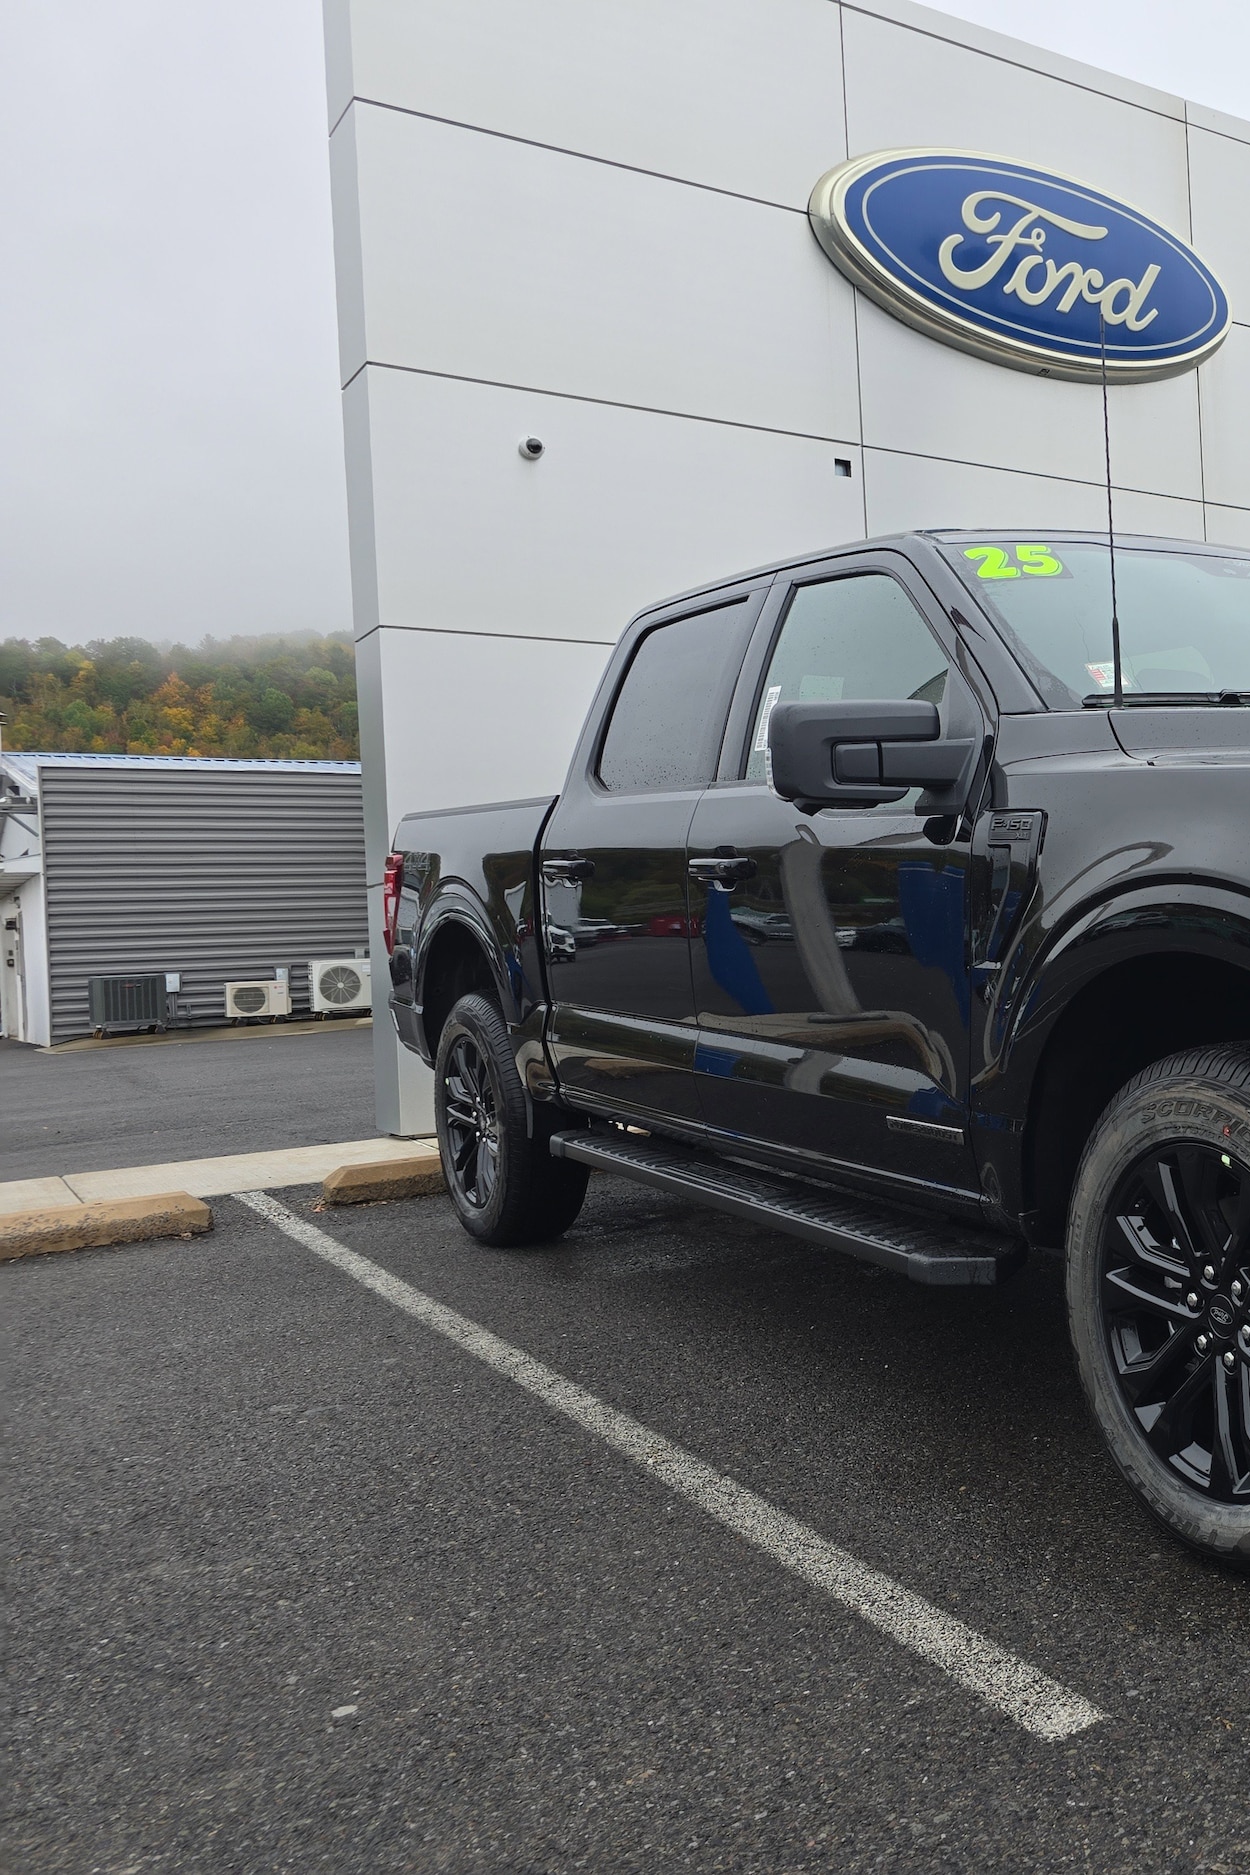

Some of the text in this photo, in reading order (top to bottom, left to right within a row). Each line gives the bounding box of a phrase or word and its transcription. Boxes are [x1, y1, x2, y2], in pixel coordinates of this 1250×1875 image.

[938, 190, 1162, 333] Ford
[963, 545, 1063, 579] 25
[1213, 1309, 1229, 1323] Ford
[1123, 1462, 1217, 1548] PIRELLI
